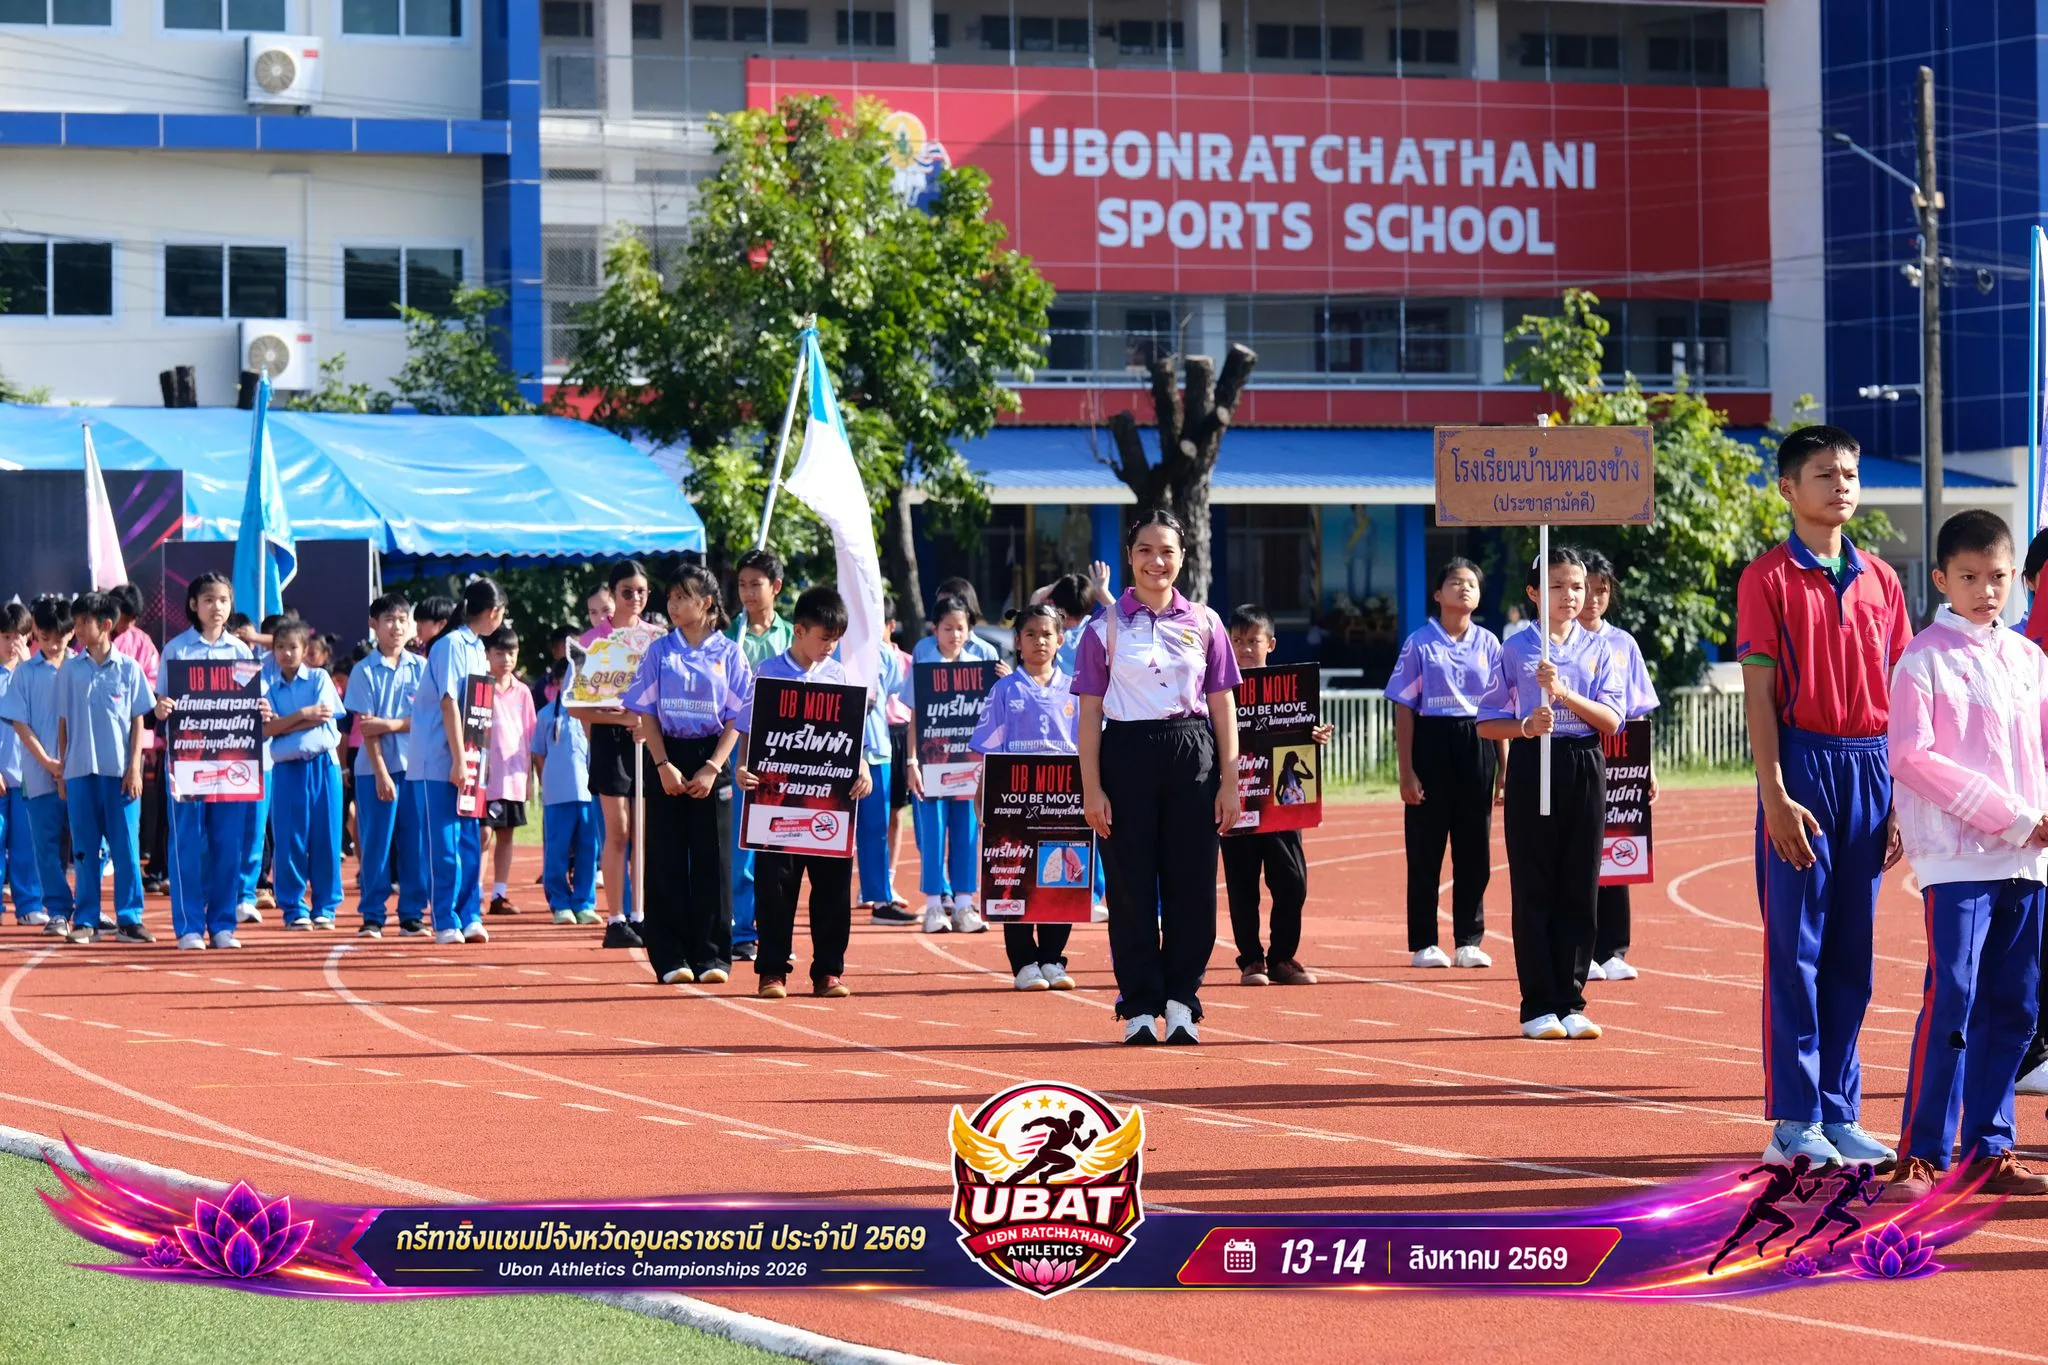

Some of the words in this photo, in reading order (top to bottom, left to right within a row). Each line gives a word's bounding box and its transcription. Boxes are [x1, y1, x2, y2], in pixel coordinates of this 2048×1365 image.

[1030, 127, 1597, 189] UBONRATCHATHANI
[1097, 197, 1314, 251] SPORTS
[1344, 203, 1556, 255] SCHOOL
[1451, 446, 1640, 482] โรงเรียนบ้านหนองช้าง
[1493, 491, 1596, 513] (ประชาสามัคคี)
[189, 666, 205, 692] UB
[210, 666, 242, 691] MOV
[932, 668, 949, 692] UB
[953, 667, 984, 692] MOVE
[1239, 678, 1256, 705] UB
[1263, 674, 1298, 704] MOVE
[779, 689, 797, 718] UB
[804, 691, 842, 723] MOVE
[1257, 704, 1272, 715] BE
[1273, 701, 1307, 714] MOVE
[1039, 714, 1050, 735] 3
[765, 723, 854, 757] บุหรี่ไฟฟ้า
[1603, 730, 1628, 758] OVE
[757, 757, 853, 779] ทำลายความมั่นคง
[1011, 764, 1029, 793] UB
[1035, 764, 1073, 793] MOVE
[778, 781, 832, 799] ของชาติ
[1001, 793, 1027, 804] YOU
[1029, 793, 1043, 804] BE
[1046, 793, 1081, 804] MOVE
[983, 842, 1034, 862] บุหรี่ไฟฟ้า
